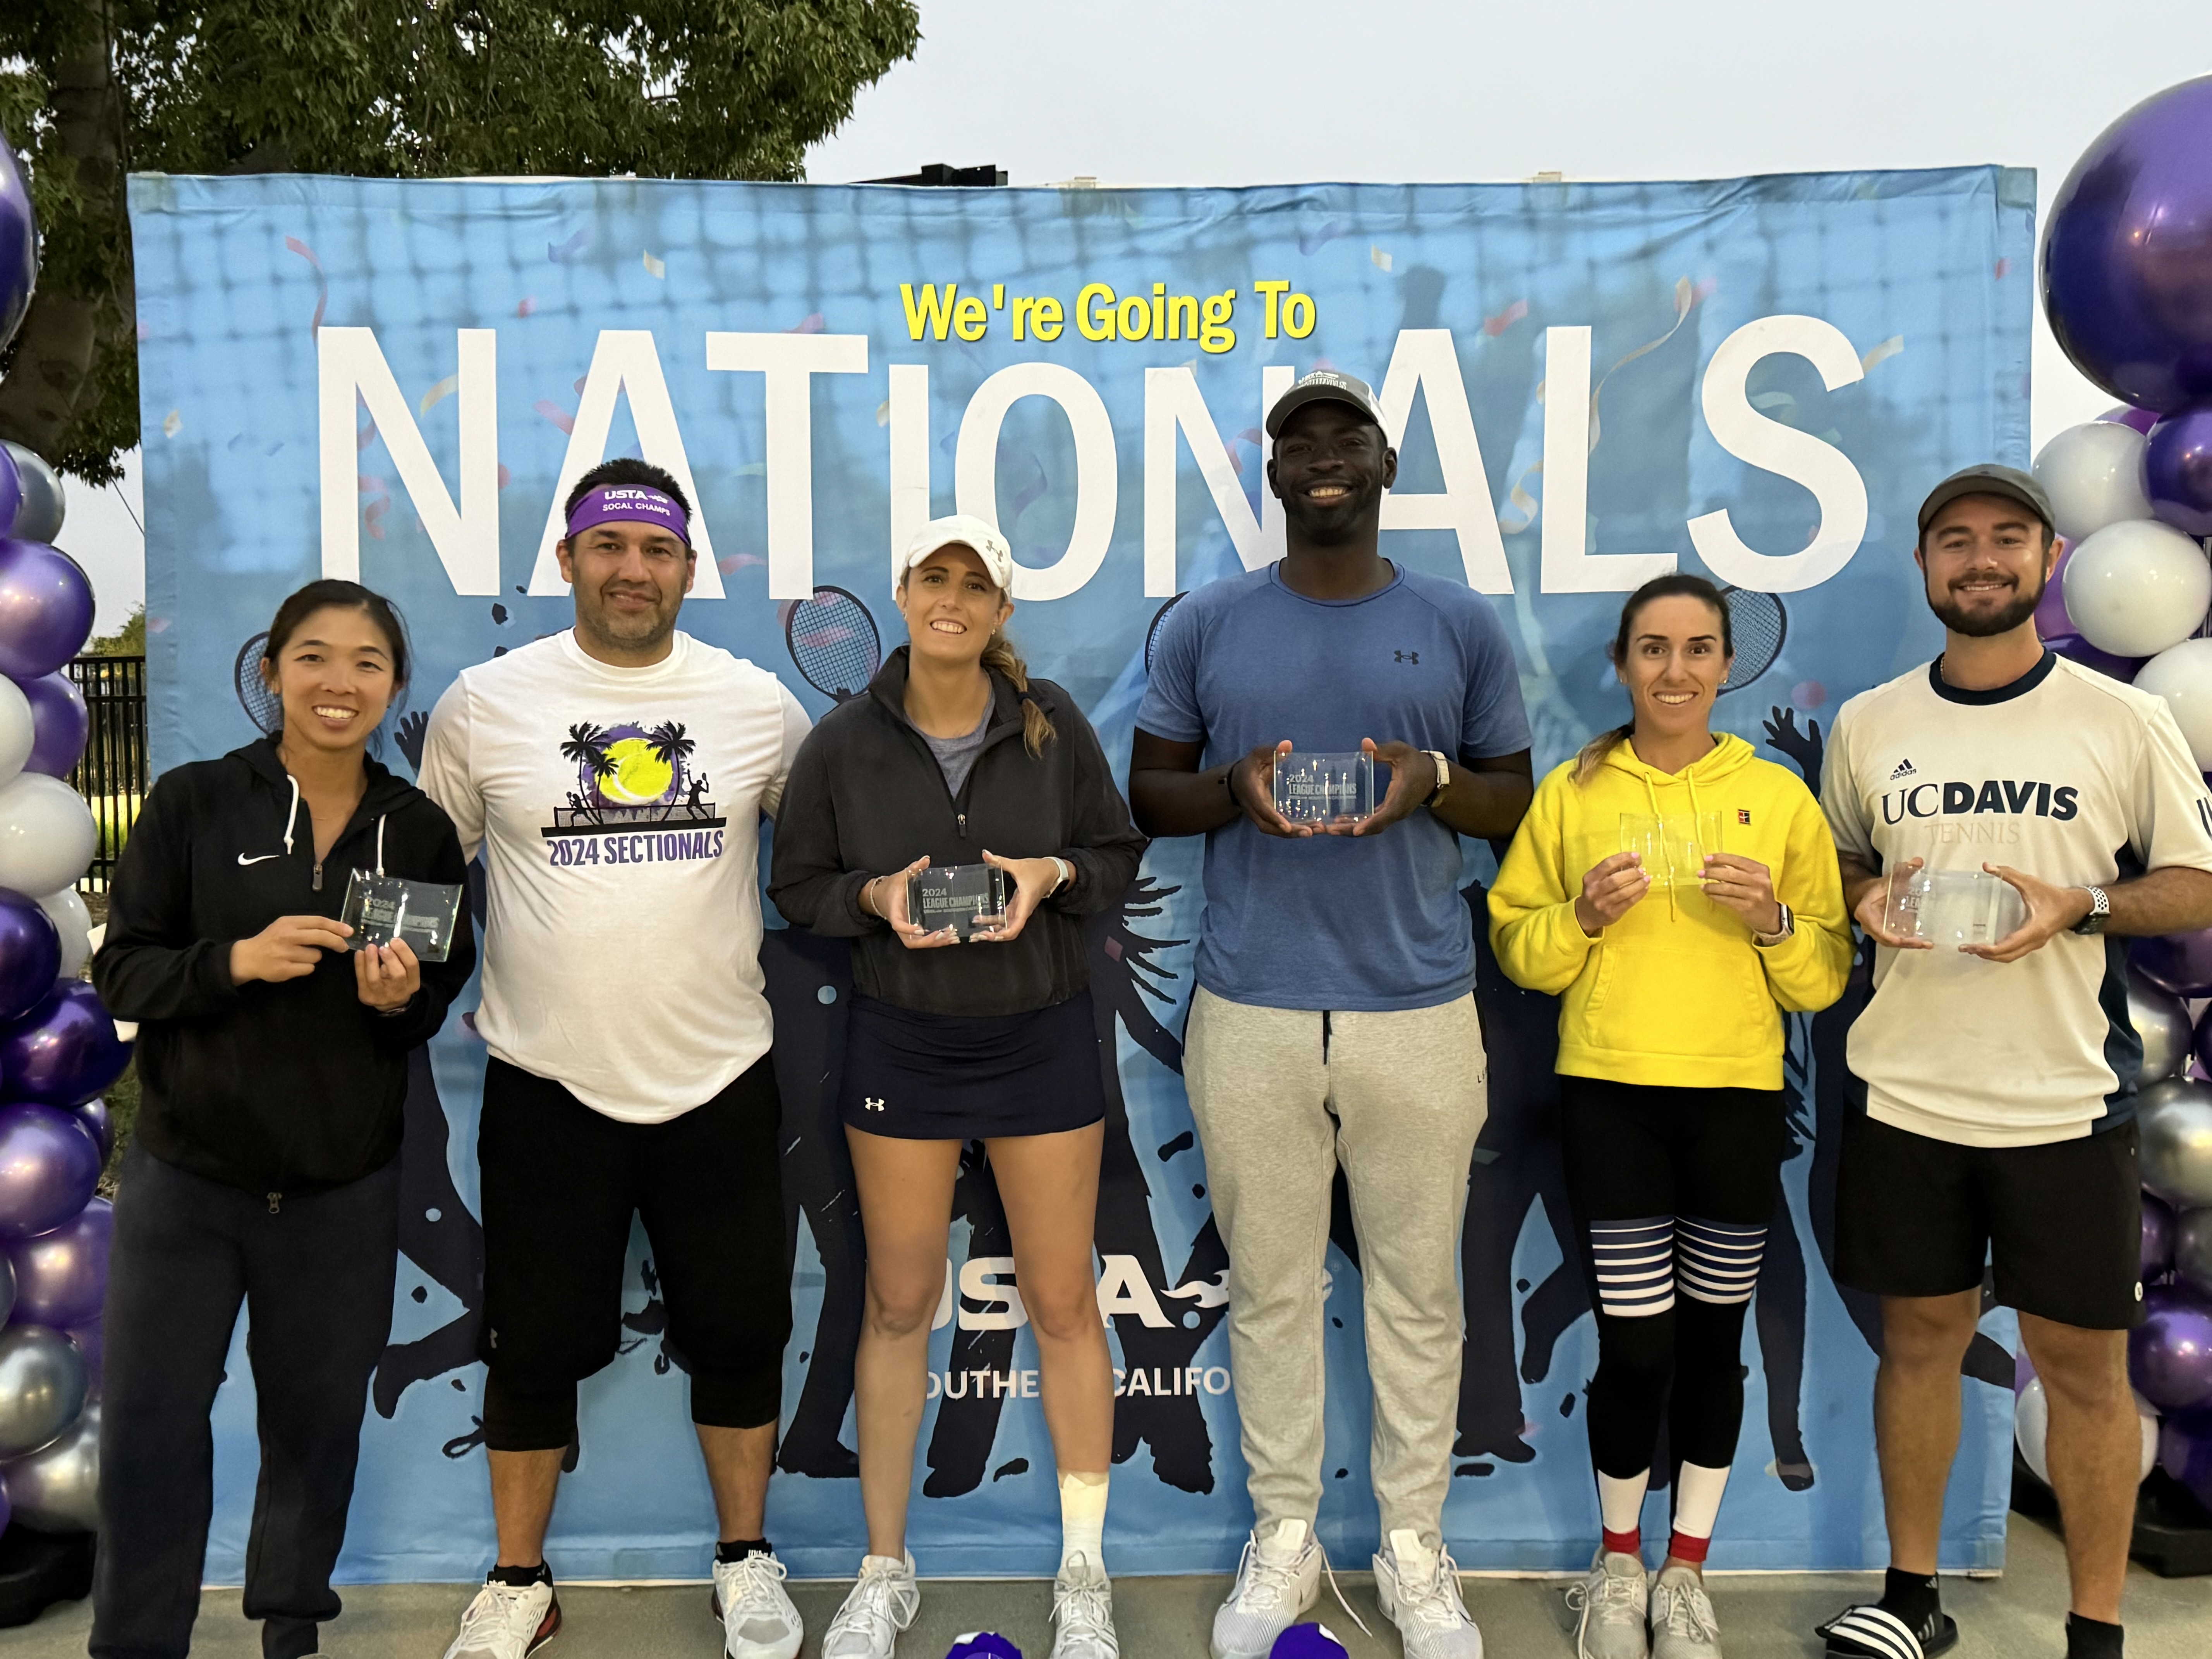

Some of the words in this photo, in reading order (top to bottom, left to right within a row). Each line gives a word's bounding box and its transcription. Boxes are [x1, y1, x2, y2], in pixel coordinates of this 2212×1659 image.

[900, 283, 1064, 342] We're
[1076, 283, 1236, 353] Going
[1255, 280, 1316, 339] To
[318, 314, 1868, 601] NATIONALS
[605, 489, 648, 500] USTA
[603, 503, 633, 511] SOCAL
[635, 503, 670, 516] CHAMPS
[1290, 774, 1314, 783] 2024
[1890, 768, 1917, 780] adidas
[1289, 784, 1314, 794] LEAGUE
[1924, 822, 2020, 845] TENNIS
[546, 838, 599, 866] 2024
[604, 830, 724, 864] SECTIONALS
[922, 888, 947, 897] 2024
[923, 897, 949, 909] LEAGUE
[931, 1254, 1176, 1331] SA
[1113, 1367, 1231, 1397] CALIFO
